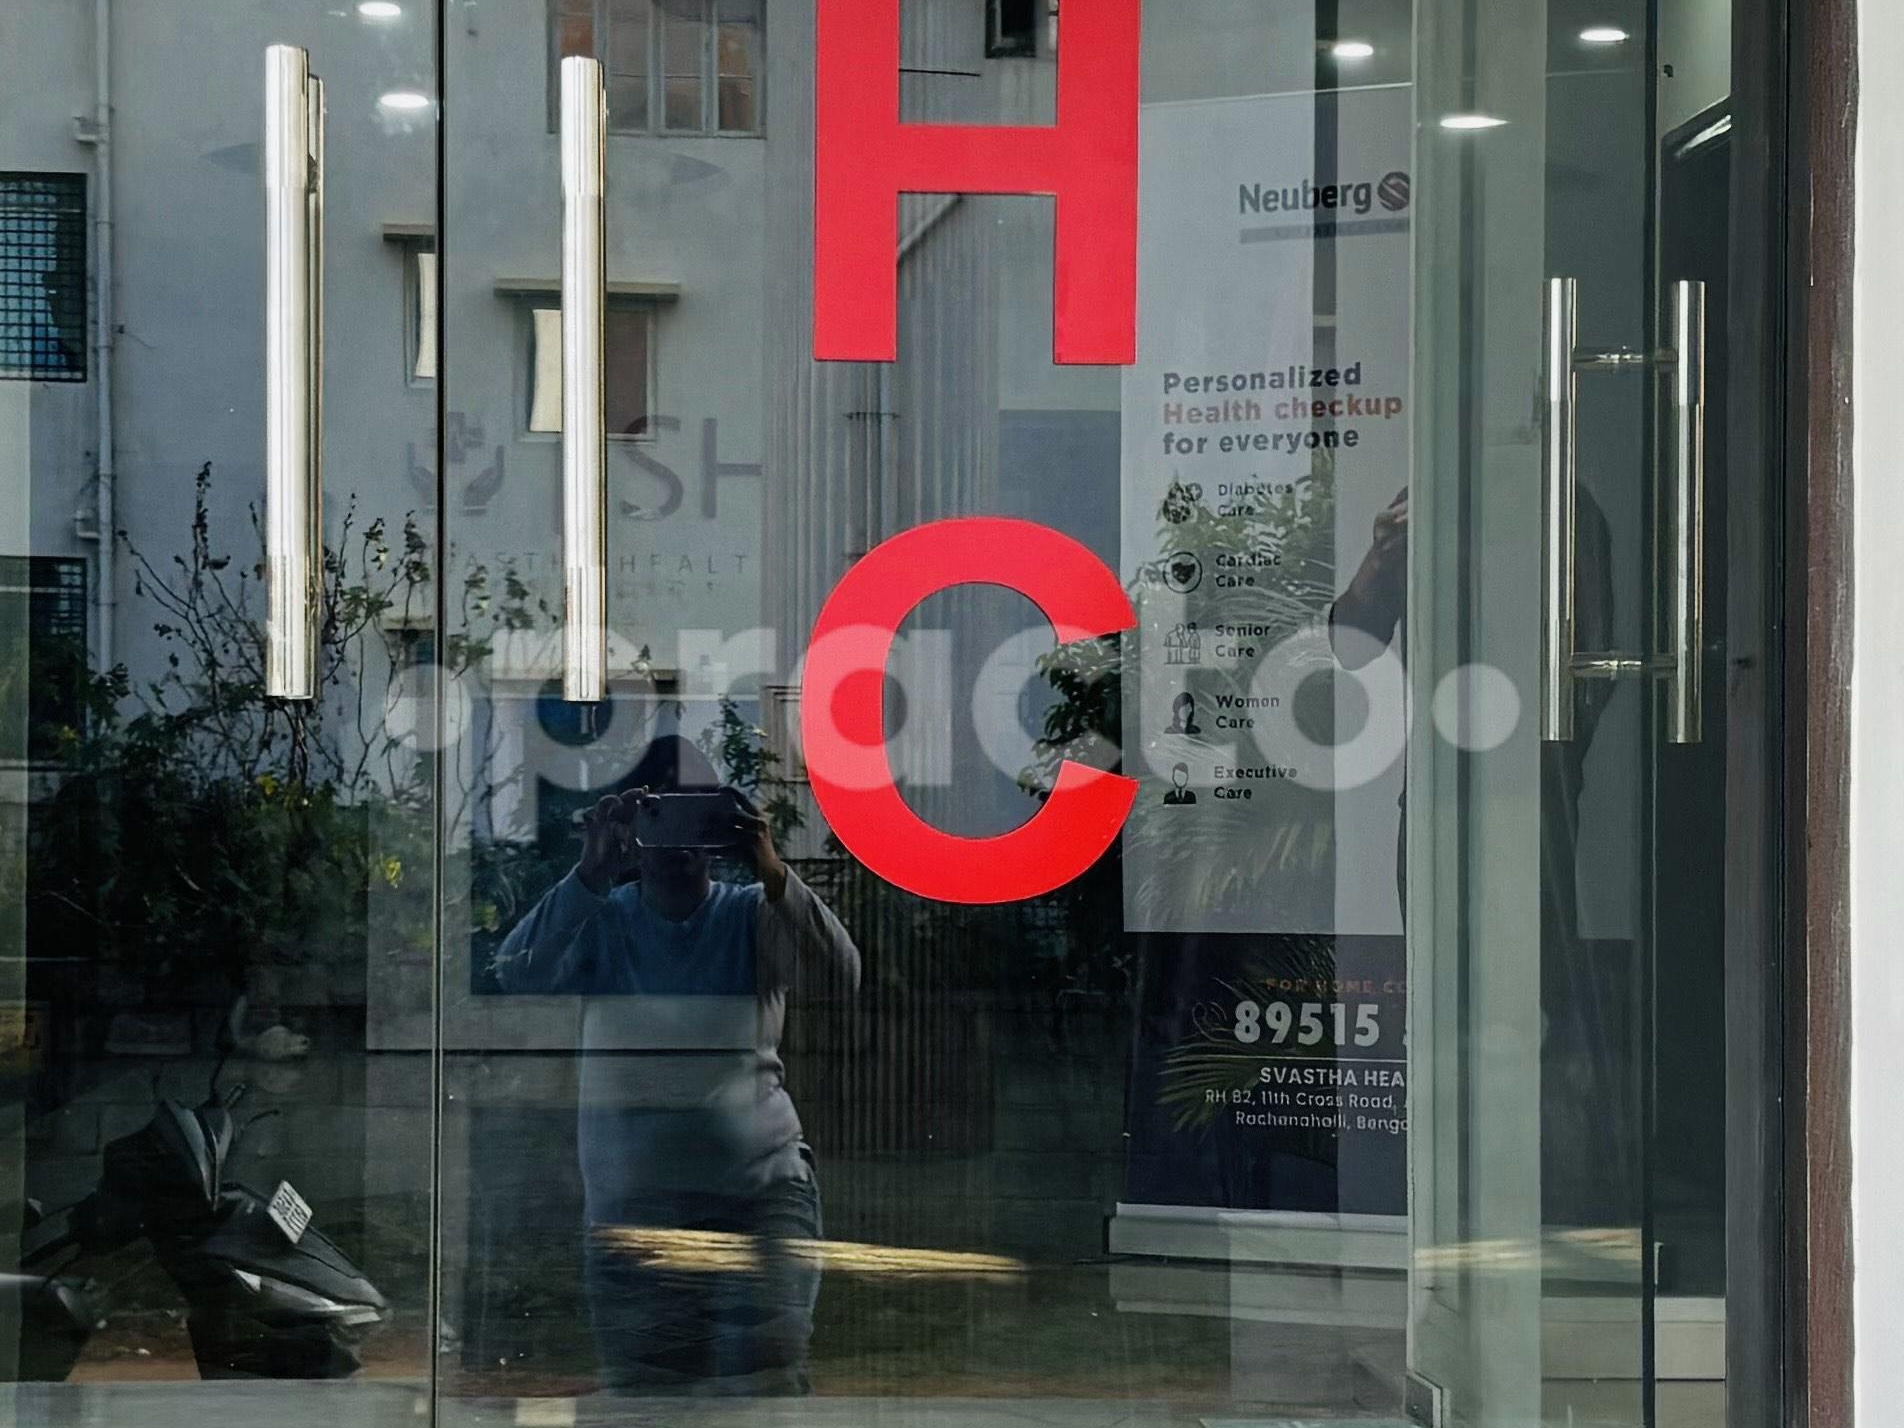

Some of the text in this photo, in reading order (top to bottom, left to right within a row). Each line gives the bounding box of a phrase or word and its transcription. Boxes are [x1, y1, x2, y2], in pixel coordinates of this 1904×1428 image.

[1239, 179, 1372, 214] Neuberg
[1163, 362, 1361, 394] Personalized
[1163, 393, 1403, 425] Health checkup
[1162, 428, 1359, 455] for everyone
[1215, 575, 1255, 588] Care
[1215, 645, 1255, 658] Care
[1215, 716, 1255, 729] Care
[1213, 765, 1298, 779] Executive
[1213, 786, 1253, 800] Care
[1234, 1000, 1380, 1046] 89515
[1259, 1067, 1358, 1086] SVASTHA
[1296, 1092, 1344, 1108] Cross
